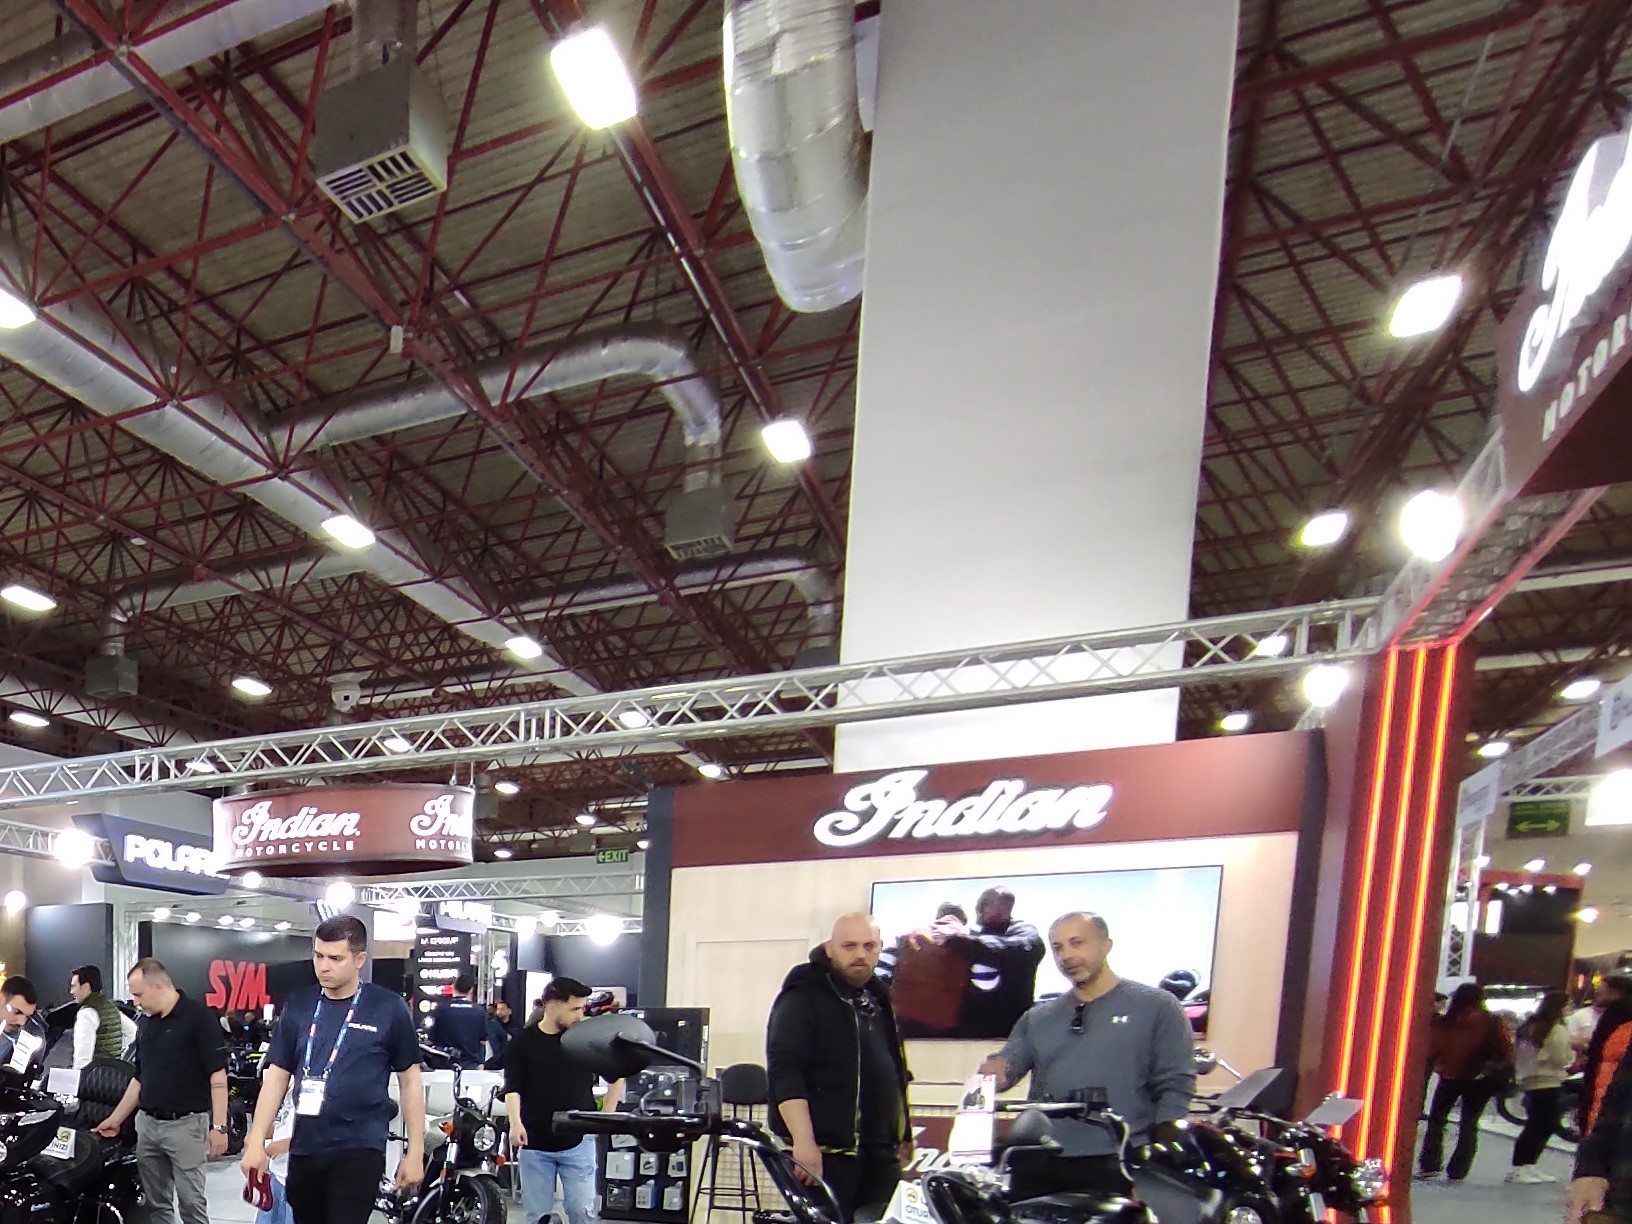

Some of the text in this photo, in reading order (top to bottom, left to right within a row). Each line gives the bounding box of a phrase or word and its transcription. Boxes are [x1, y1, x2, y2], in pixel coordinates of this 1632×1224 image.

[232, 800, 361, 846] Indian
[813, 770, 1114, 847] Indian
[123, 833, 230, 880] POLAR
[234, 840, 355, 858] MOTORCYCLE
[605, 850, 627, 863] EXIT
[205, 959, 271, 1010] SYM
